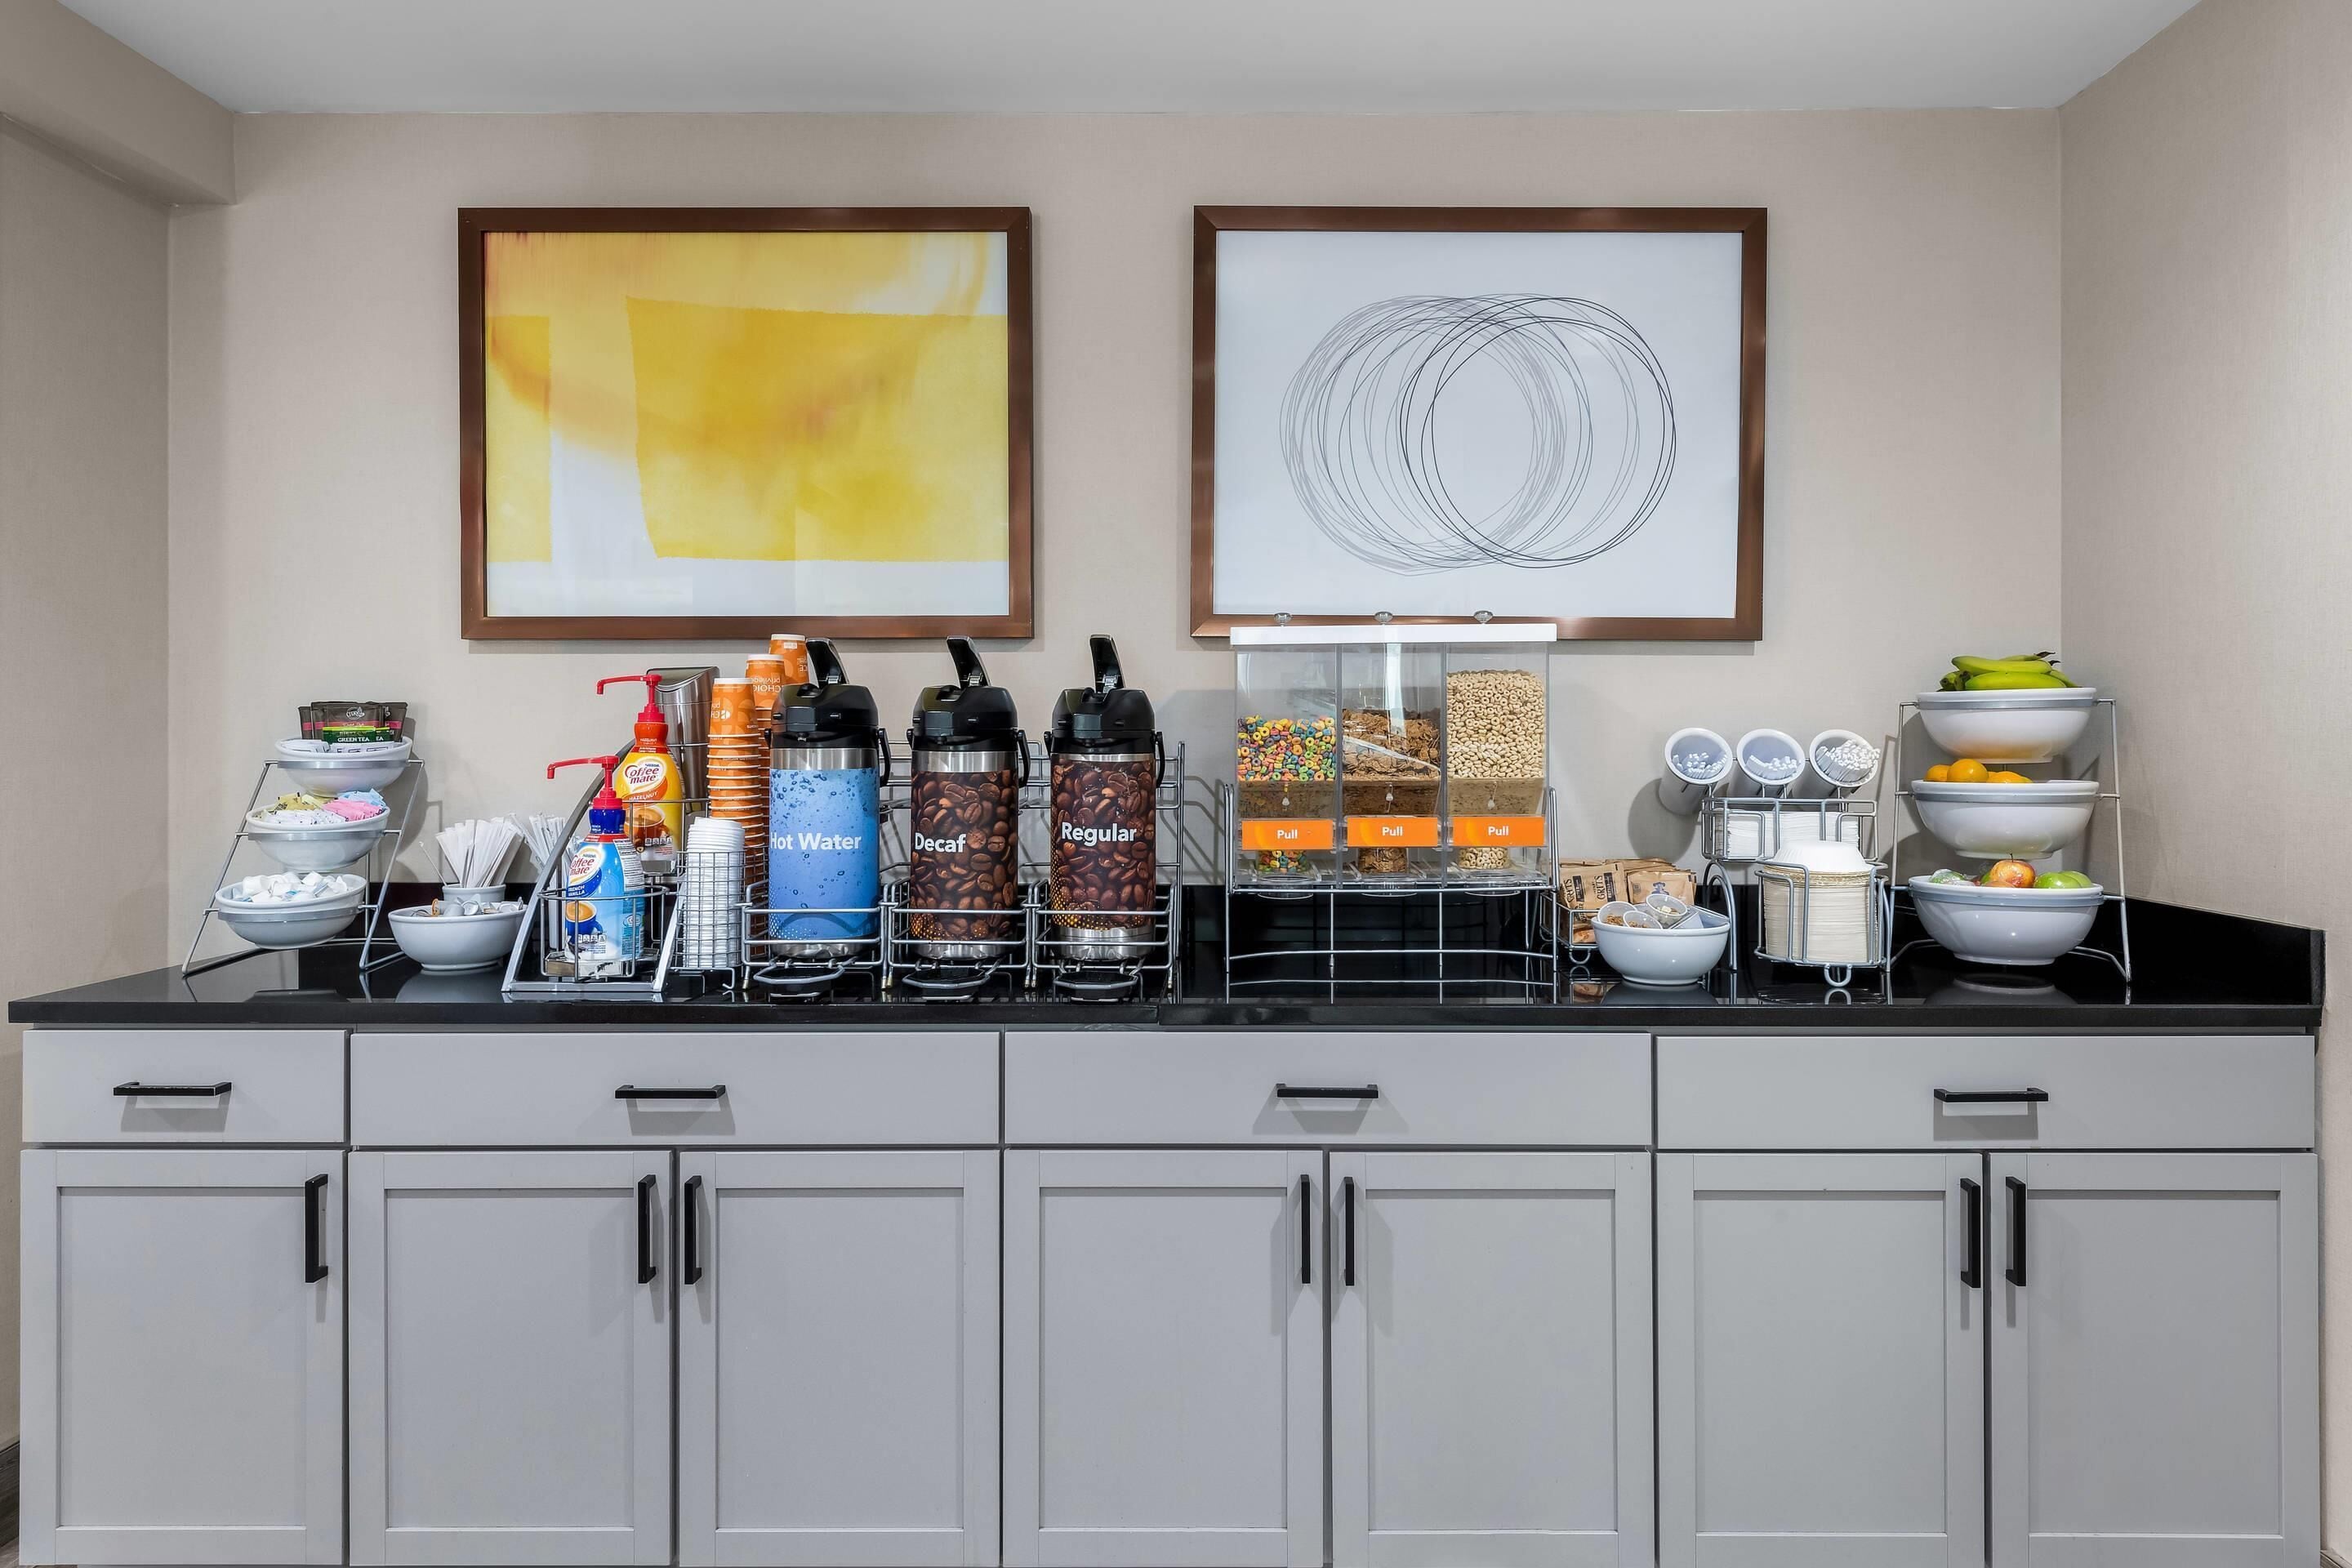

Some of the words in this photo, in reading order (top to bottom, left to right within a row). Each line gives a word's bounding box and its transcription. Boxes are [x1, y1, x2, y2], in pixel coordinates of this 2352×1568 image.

[625, 764, 660, 778] Coffee
[630, 775, 657, 785] mate
[629, 791, 658, 800] HAZELNUT
[1062, 822, 1137, 847] Regular
[1276, 829, 1298, 840] Pull
[1382, 826, 1403, 836] Pull
[1488, 826, 1509, 836] Pull
[770, 832, 793, 850] Hot
[798, 832, 862, 850] Water
[915, 832, 967, 853] Decaf
[1564, 879, 1575, 902] GRITS
[1594, 875, 1606, 900] GRITS
